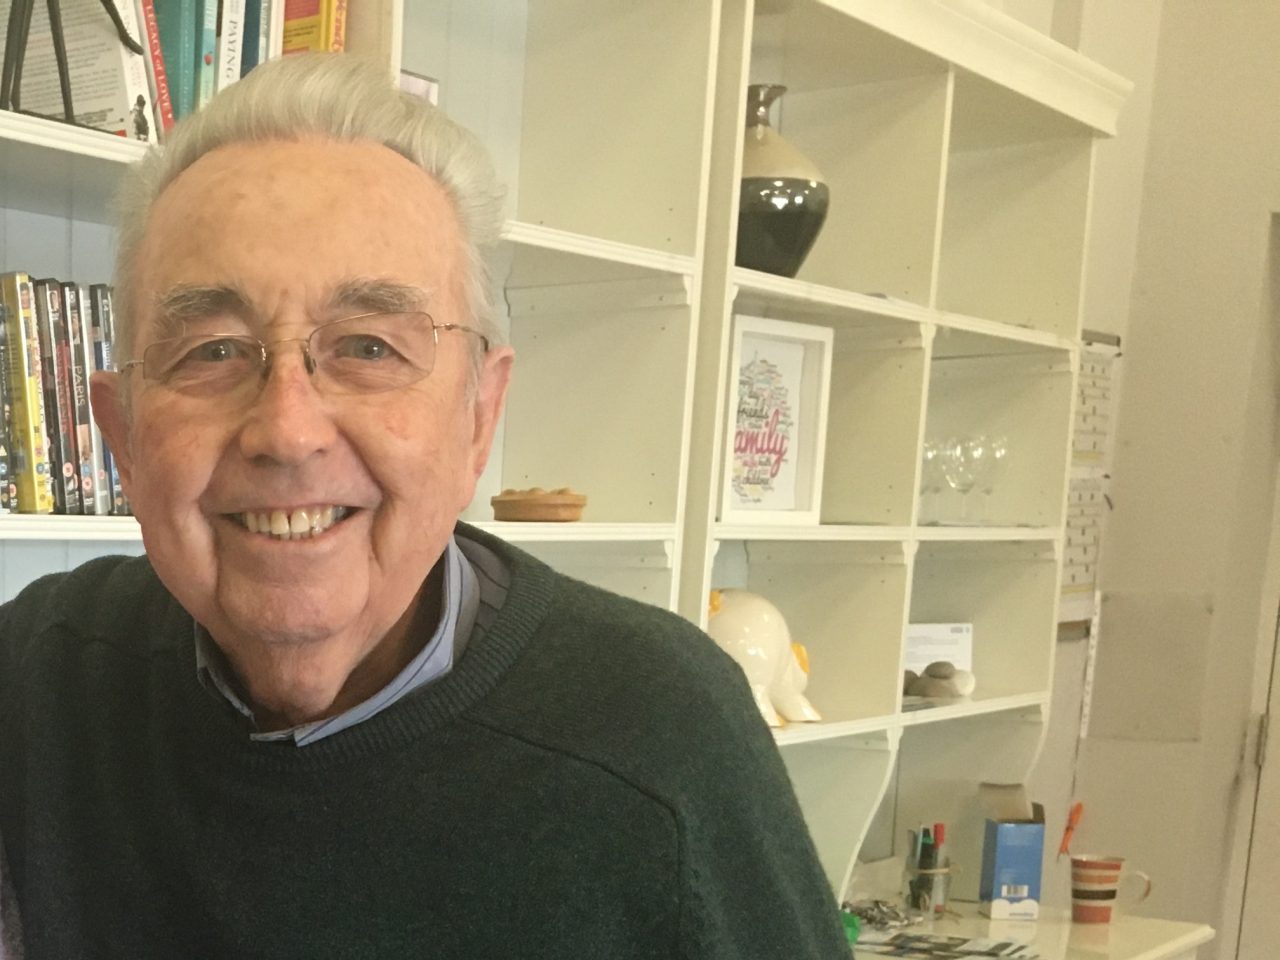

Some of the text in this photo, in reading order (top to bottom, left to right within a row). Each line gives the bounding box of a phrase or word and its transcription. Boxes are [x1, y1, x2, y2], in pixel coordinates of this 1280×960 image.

[145, 4, 162, 57] LEGACY
[158, 75, 171, 111] LOVE
[226, 19, 239, 80] PAYING
[73, 364, 86, 407] PARIS
